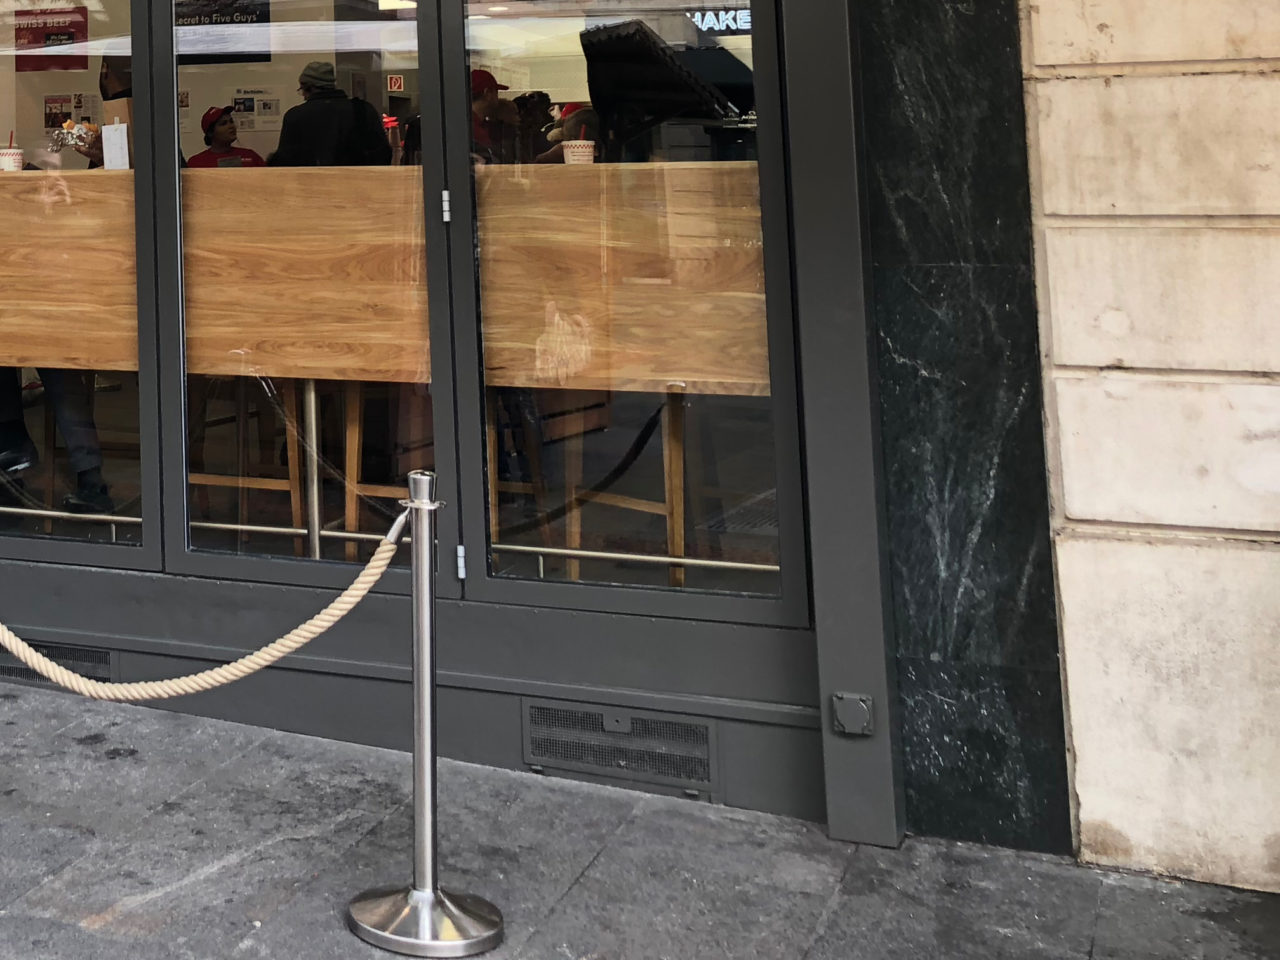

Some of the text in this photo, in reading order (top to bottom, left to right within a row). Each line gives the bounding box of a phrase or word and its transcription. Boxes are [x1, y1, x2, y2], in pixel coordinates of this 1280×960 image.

[176, 16, 199, 25] ecret
[201, 15, 210, 24] to
[212, 13, 231, 23] Five
